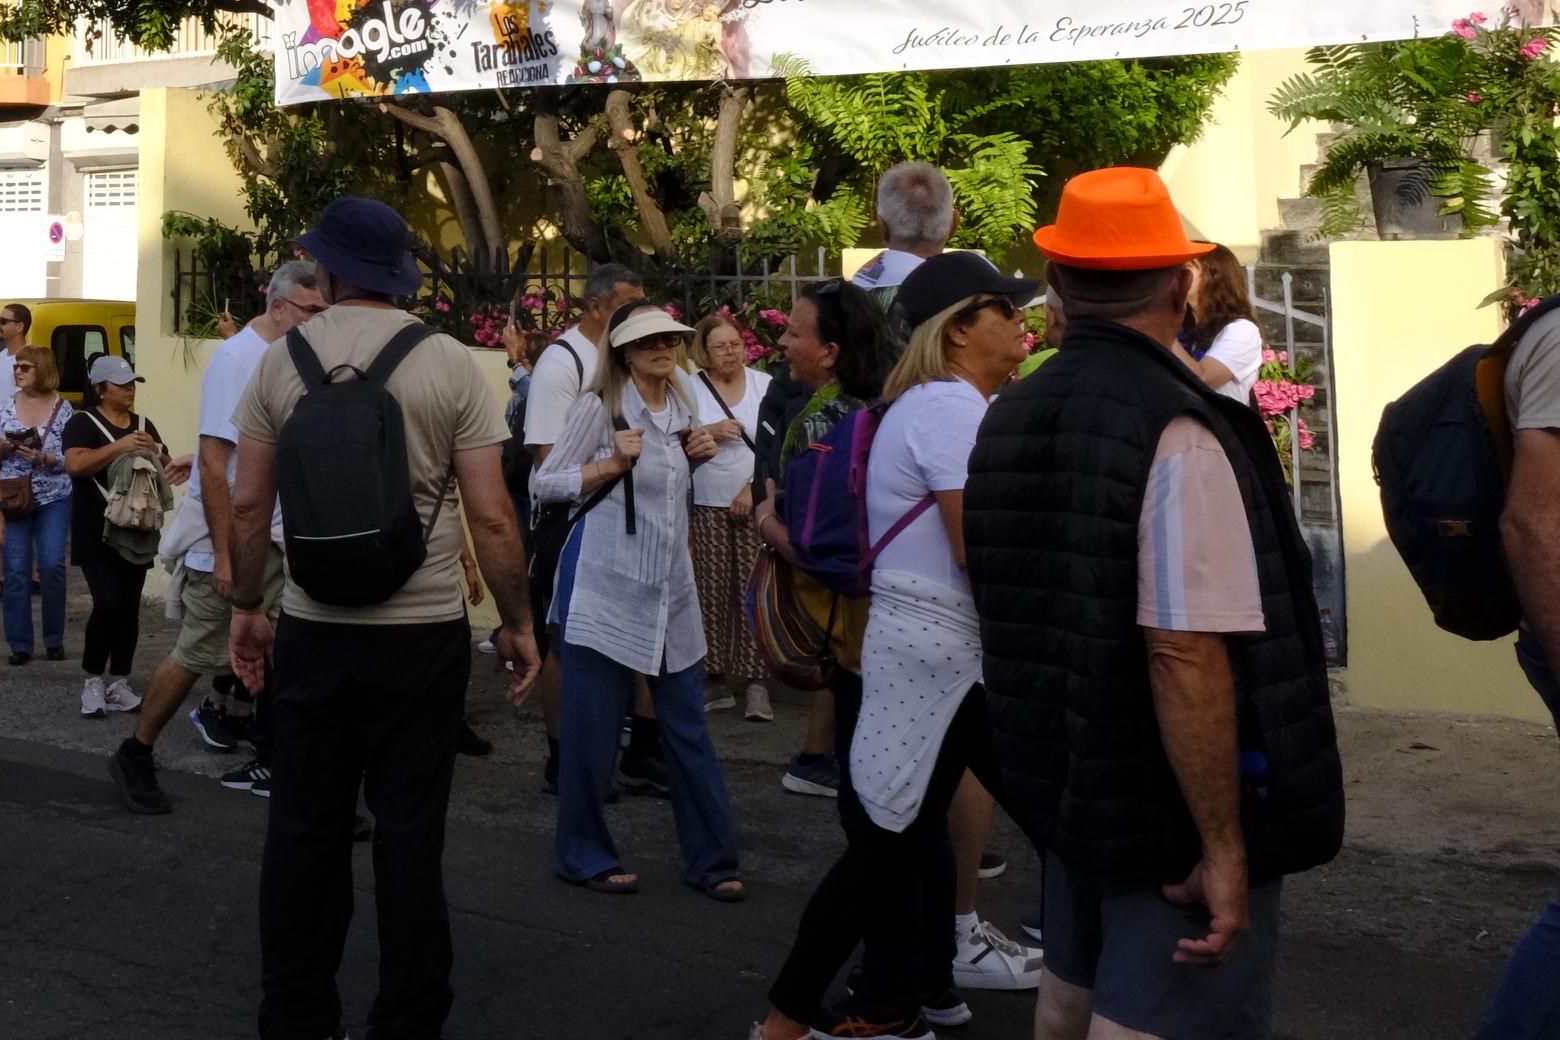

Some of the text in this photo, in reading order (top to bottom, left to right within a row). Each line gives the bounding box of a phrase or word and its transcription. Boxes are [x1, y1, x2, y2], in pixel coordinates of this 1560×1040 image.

[282, 0, 425, 80] imagle
[494, 13, 520, 37] Los
[892, 0, 1249, 55] Jubileo de la Esperanza 2025
